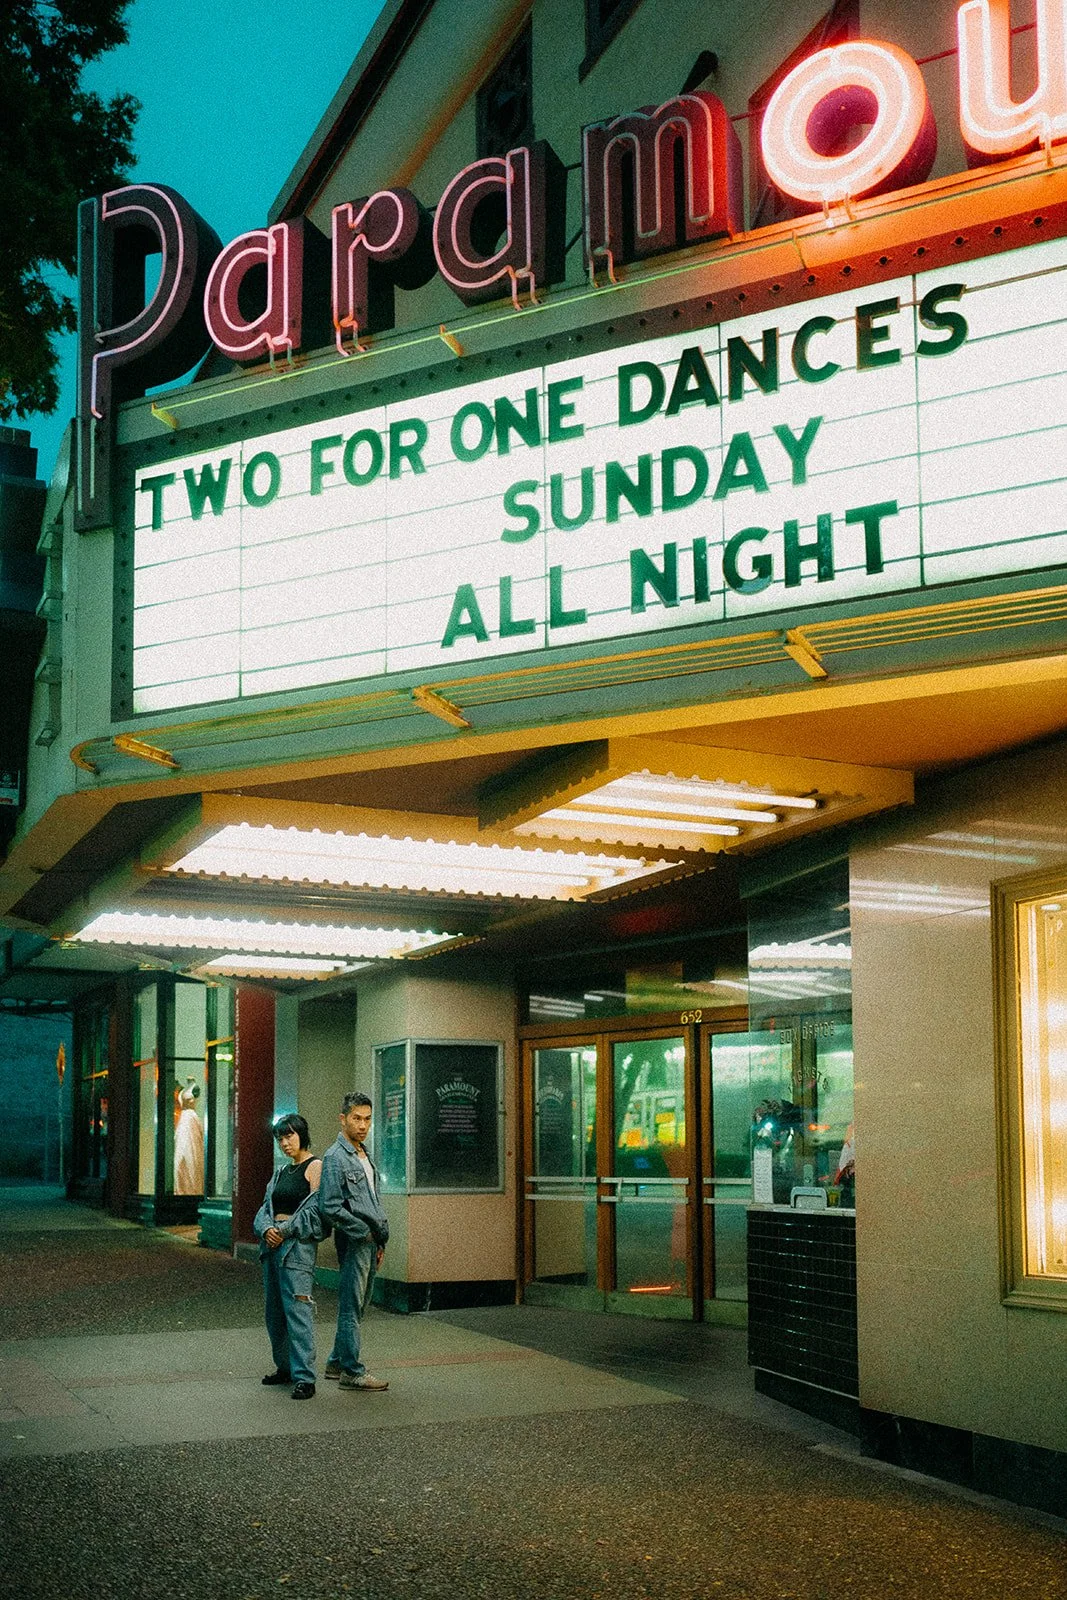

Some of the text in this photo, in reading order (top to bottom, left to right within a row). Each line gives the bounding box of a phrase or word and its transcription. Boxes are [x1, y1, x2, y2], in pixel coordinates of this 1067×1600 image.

[140, 284, 968, 530] TWO FOR ONE DANCES
[500, 417, 823, 543] SUNDAY
[441, 499, 898, 648] ALL NIGHT
[681, 1009, 703, 1024] 652
[435, 1082, 480, 1097] PARAMOUNT
